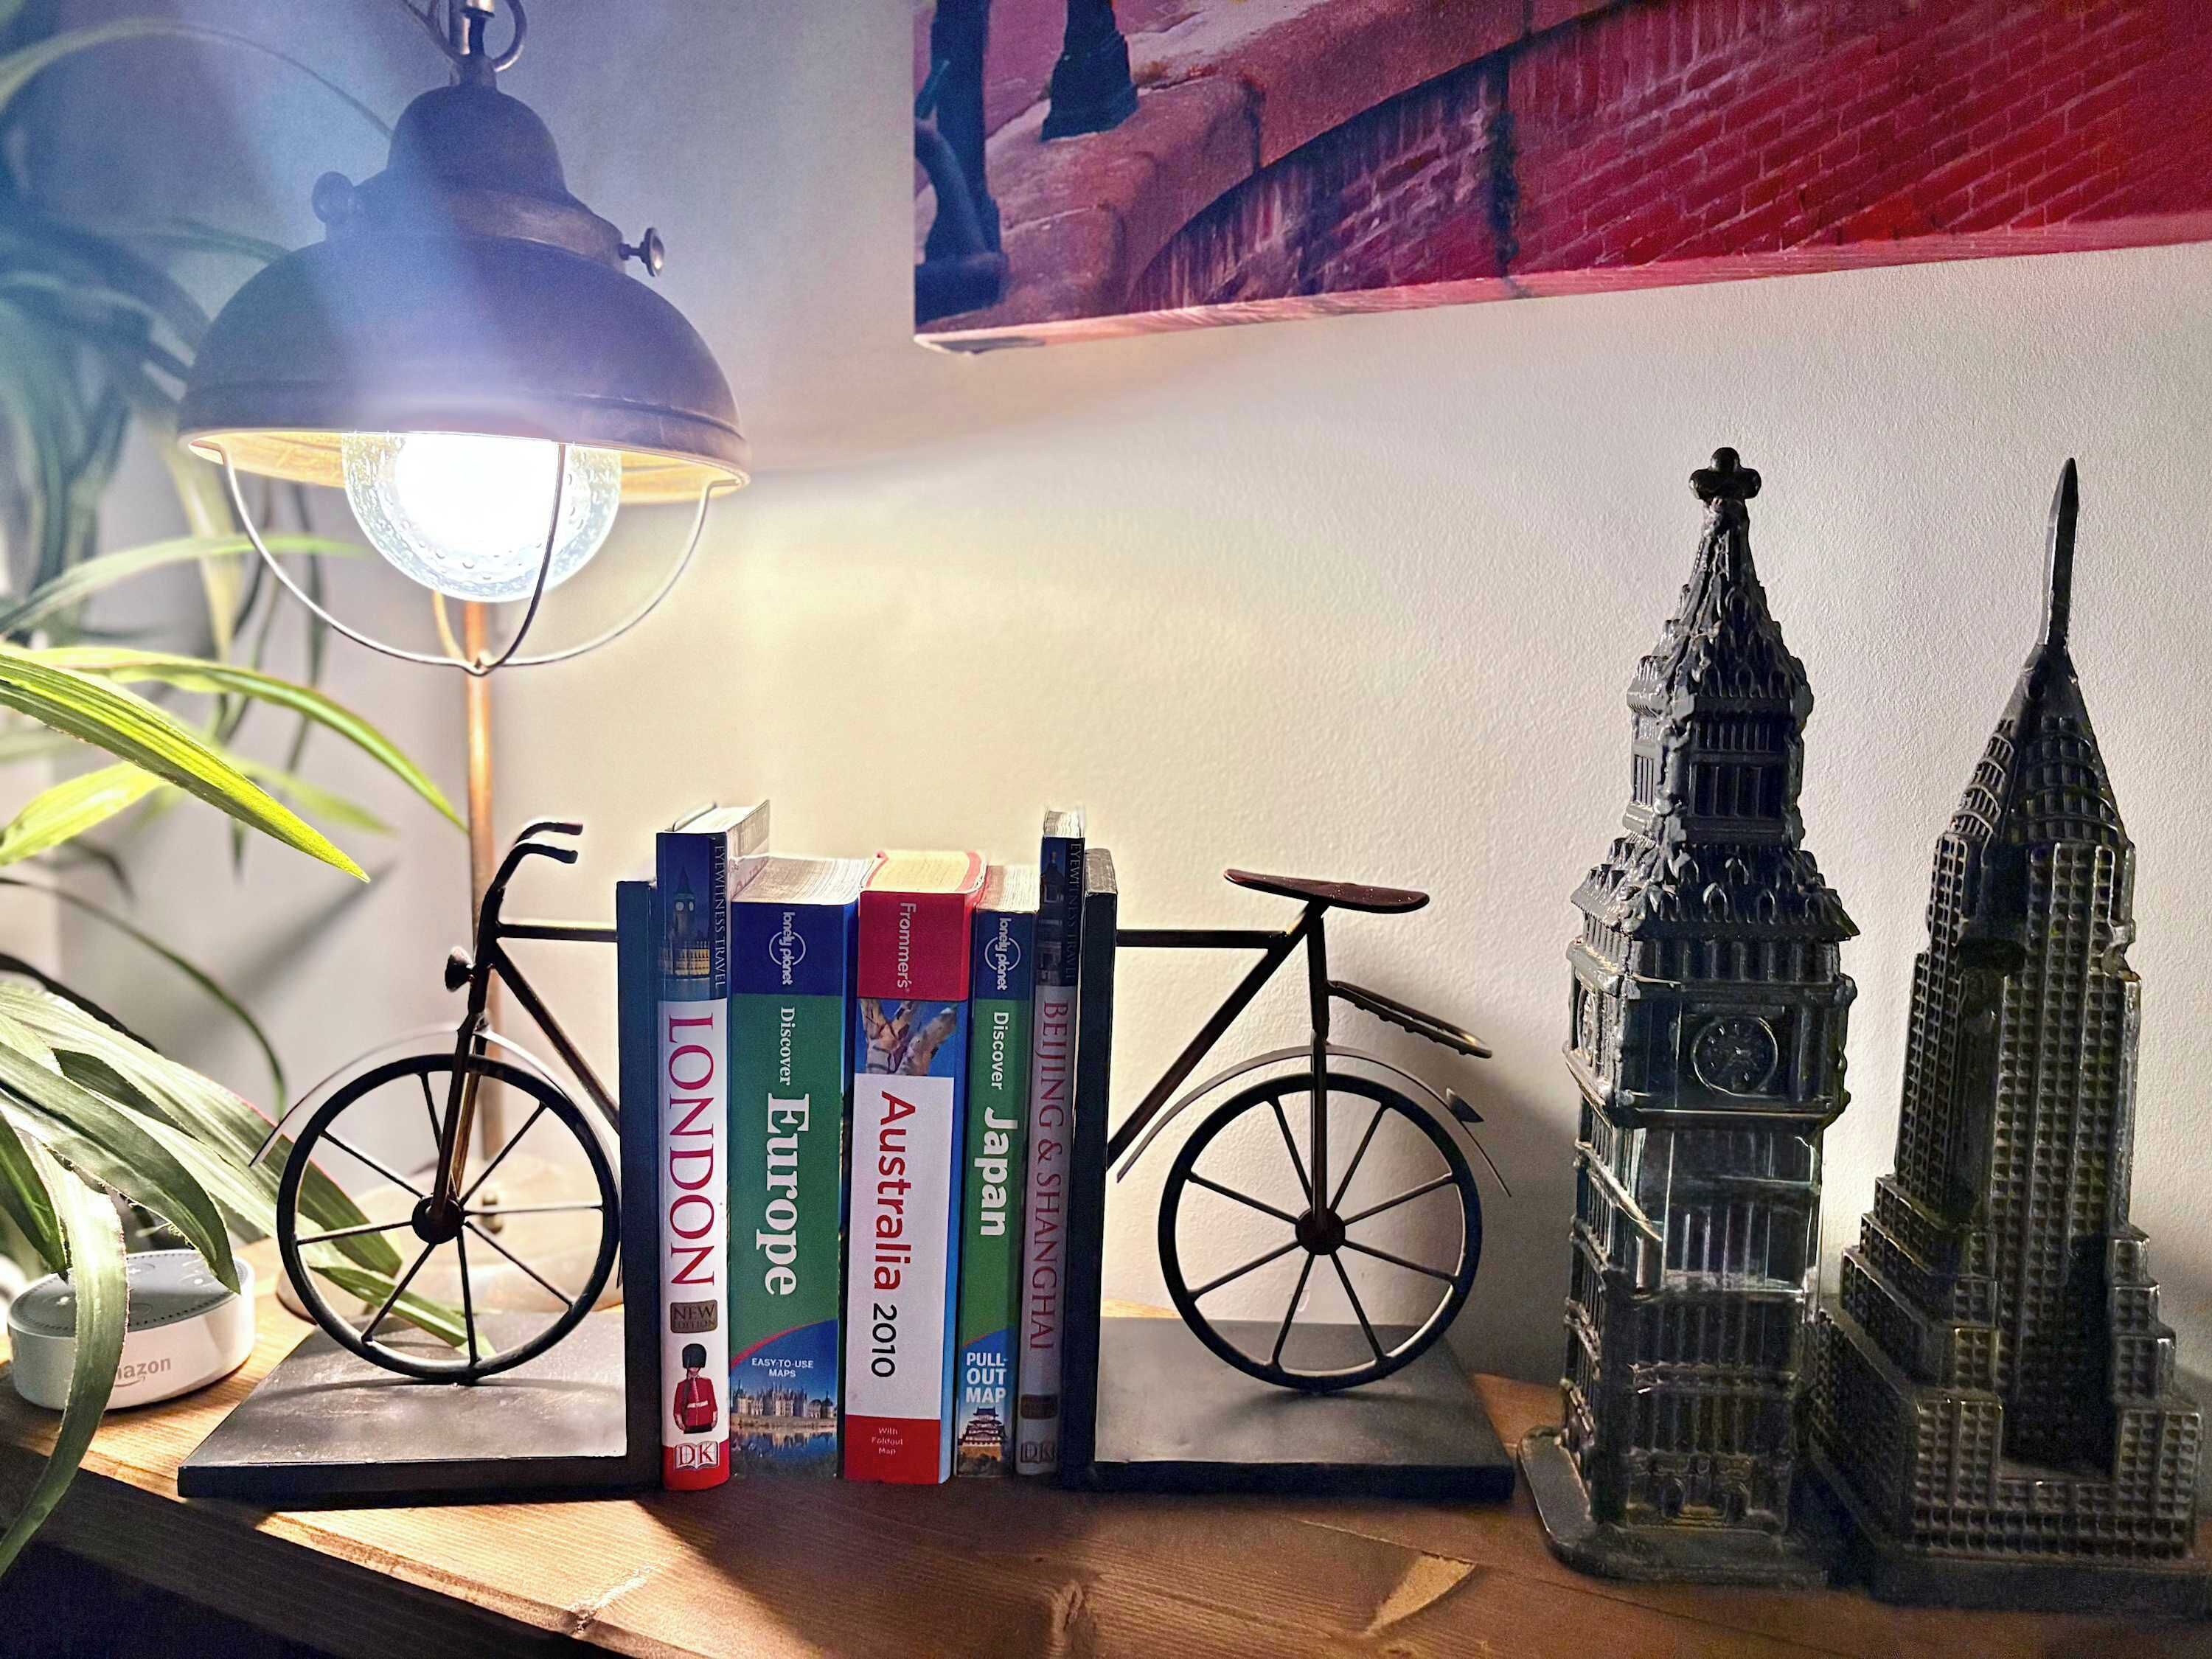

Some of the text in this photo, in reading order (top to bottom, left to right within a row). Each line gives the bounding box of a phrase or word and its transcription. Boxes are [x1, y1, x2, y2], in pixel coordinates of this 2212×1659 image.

[714, 845, 726, 987] EYEWITNESS TRAVEL
[779, 911, 795, 985] lonely planet
[897, 902, 917, 989] Frommer's
[995, 917, 1012, 990] lonely planet
[669, 1012, 715, 1286] LONDON
[756, 1006, 810, 1295] Discover Europe
[974, 1012, 1018, 1236] Discover Japan
[1029, 1001, 1068, 1351] BEIJING & SHANGHAI
[871, 1091, 916, 1377] Australia 2010
[751, 1357, 813, 1368] EASY-TO-USE
[769, 1368, 796, 1377] MAPS
[965, 1387, 1006, 1403] MAP
[966, 1368, 1006, 1385] OUT
[678, 1443, 714, 1466] DK
